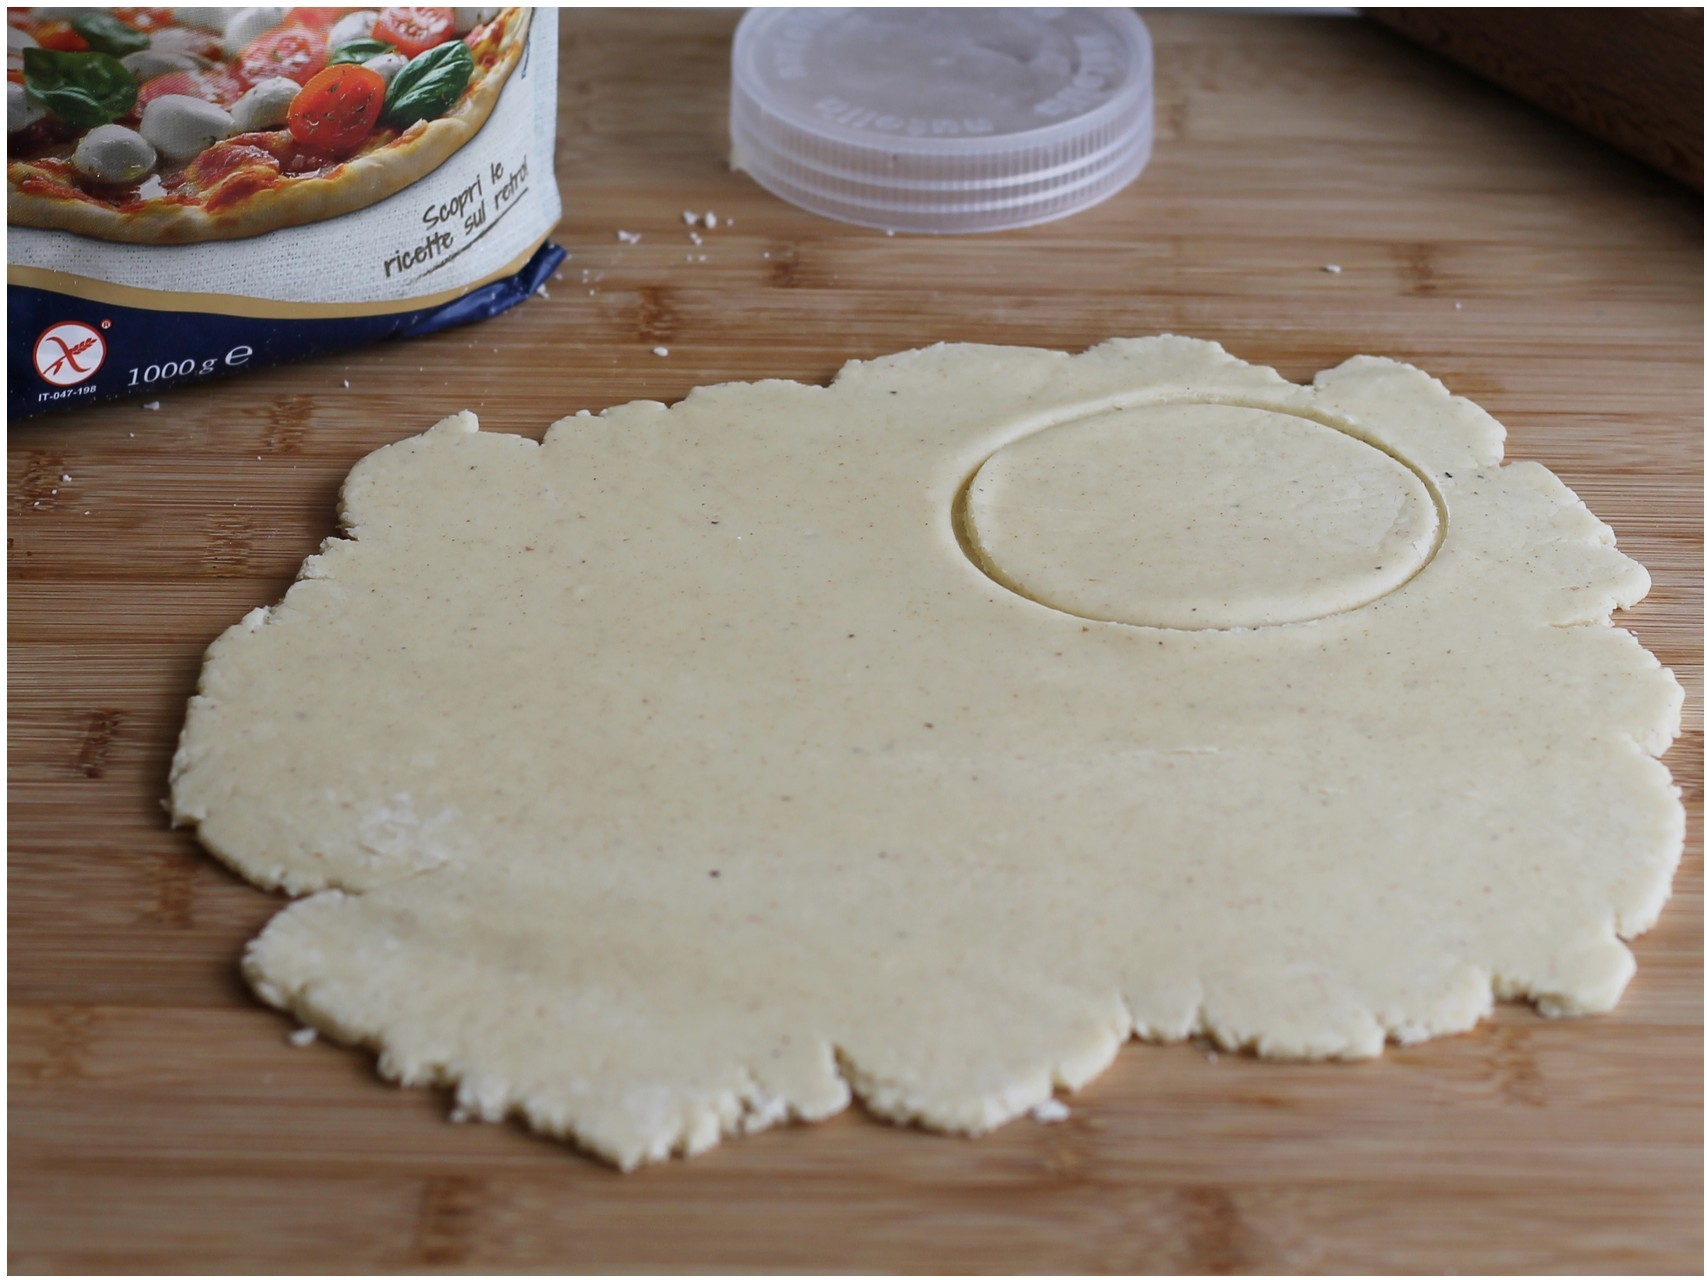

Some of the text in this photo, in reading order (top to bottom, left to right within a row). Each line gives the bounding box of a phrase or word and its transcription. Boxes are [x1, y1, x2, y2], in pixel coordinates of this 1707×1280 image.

[422, 162, 504, 231] Scopri le
[384, 232, 454, 278] ricette
[464, 199, 486, 236] sul
[38, 385, 97, 402] IT-047-198
[127, 359, 195, 387] 1000
[199, 358, 219, 375] g
